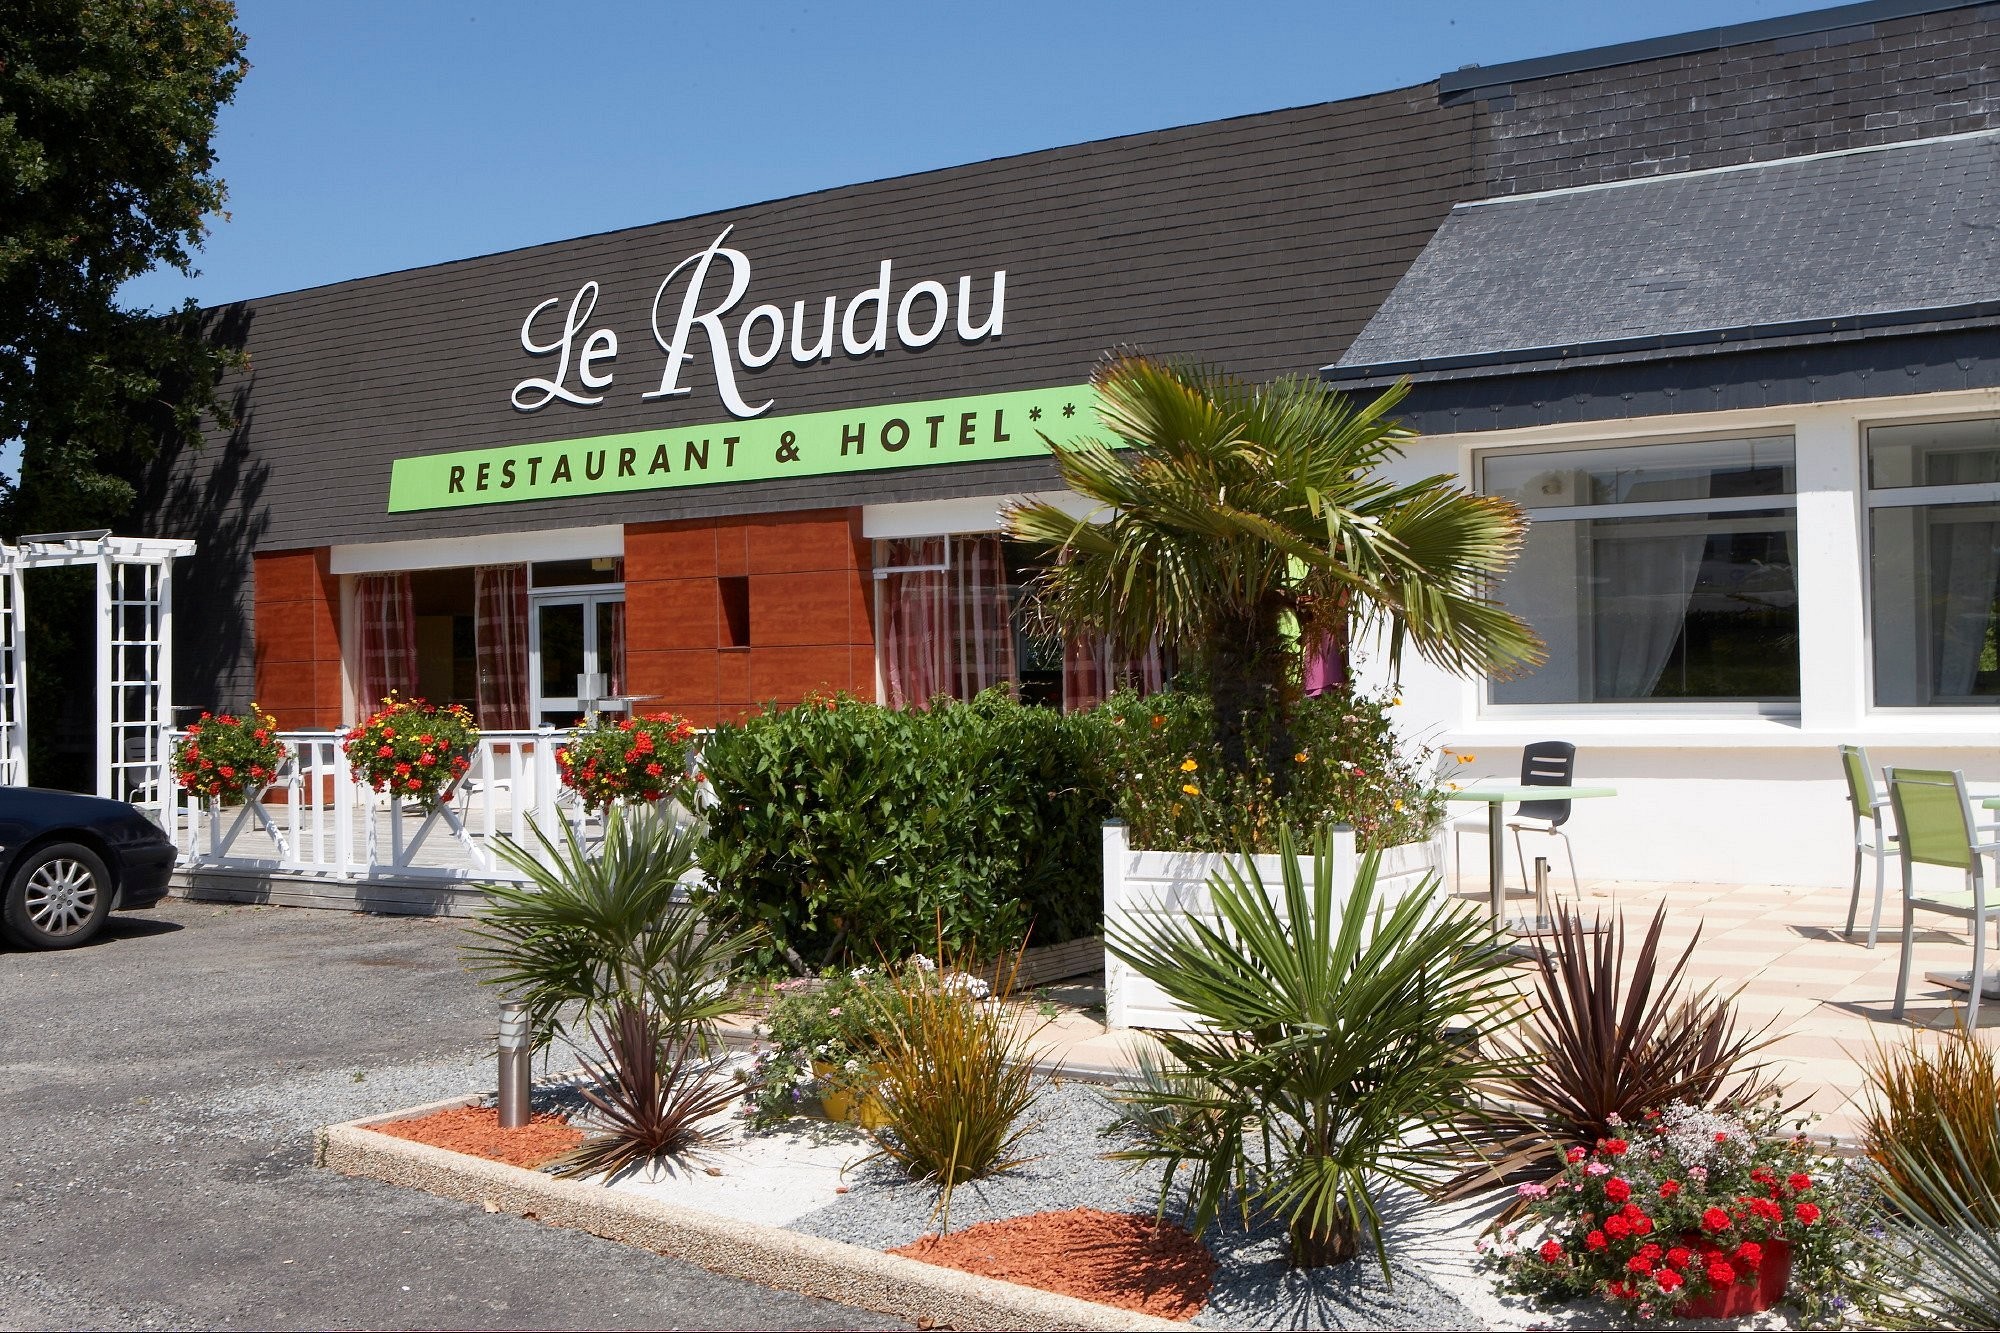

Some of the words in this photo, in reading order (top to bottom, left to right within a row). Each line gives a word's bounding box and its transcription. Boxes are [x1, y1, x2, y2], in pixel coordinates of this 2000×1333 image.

[511, 280, 618, 410] Le
[641, 223, 1007, 418] Roudou
[448, 436, 741, 494] RESTAURANT
[775, 430, 801, 464] &
